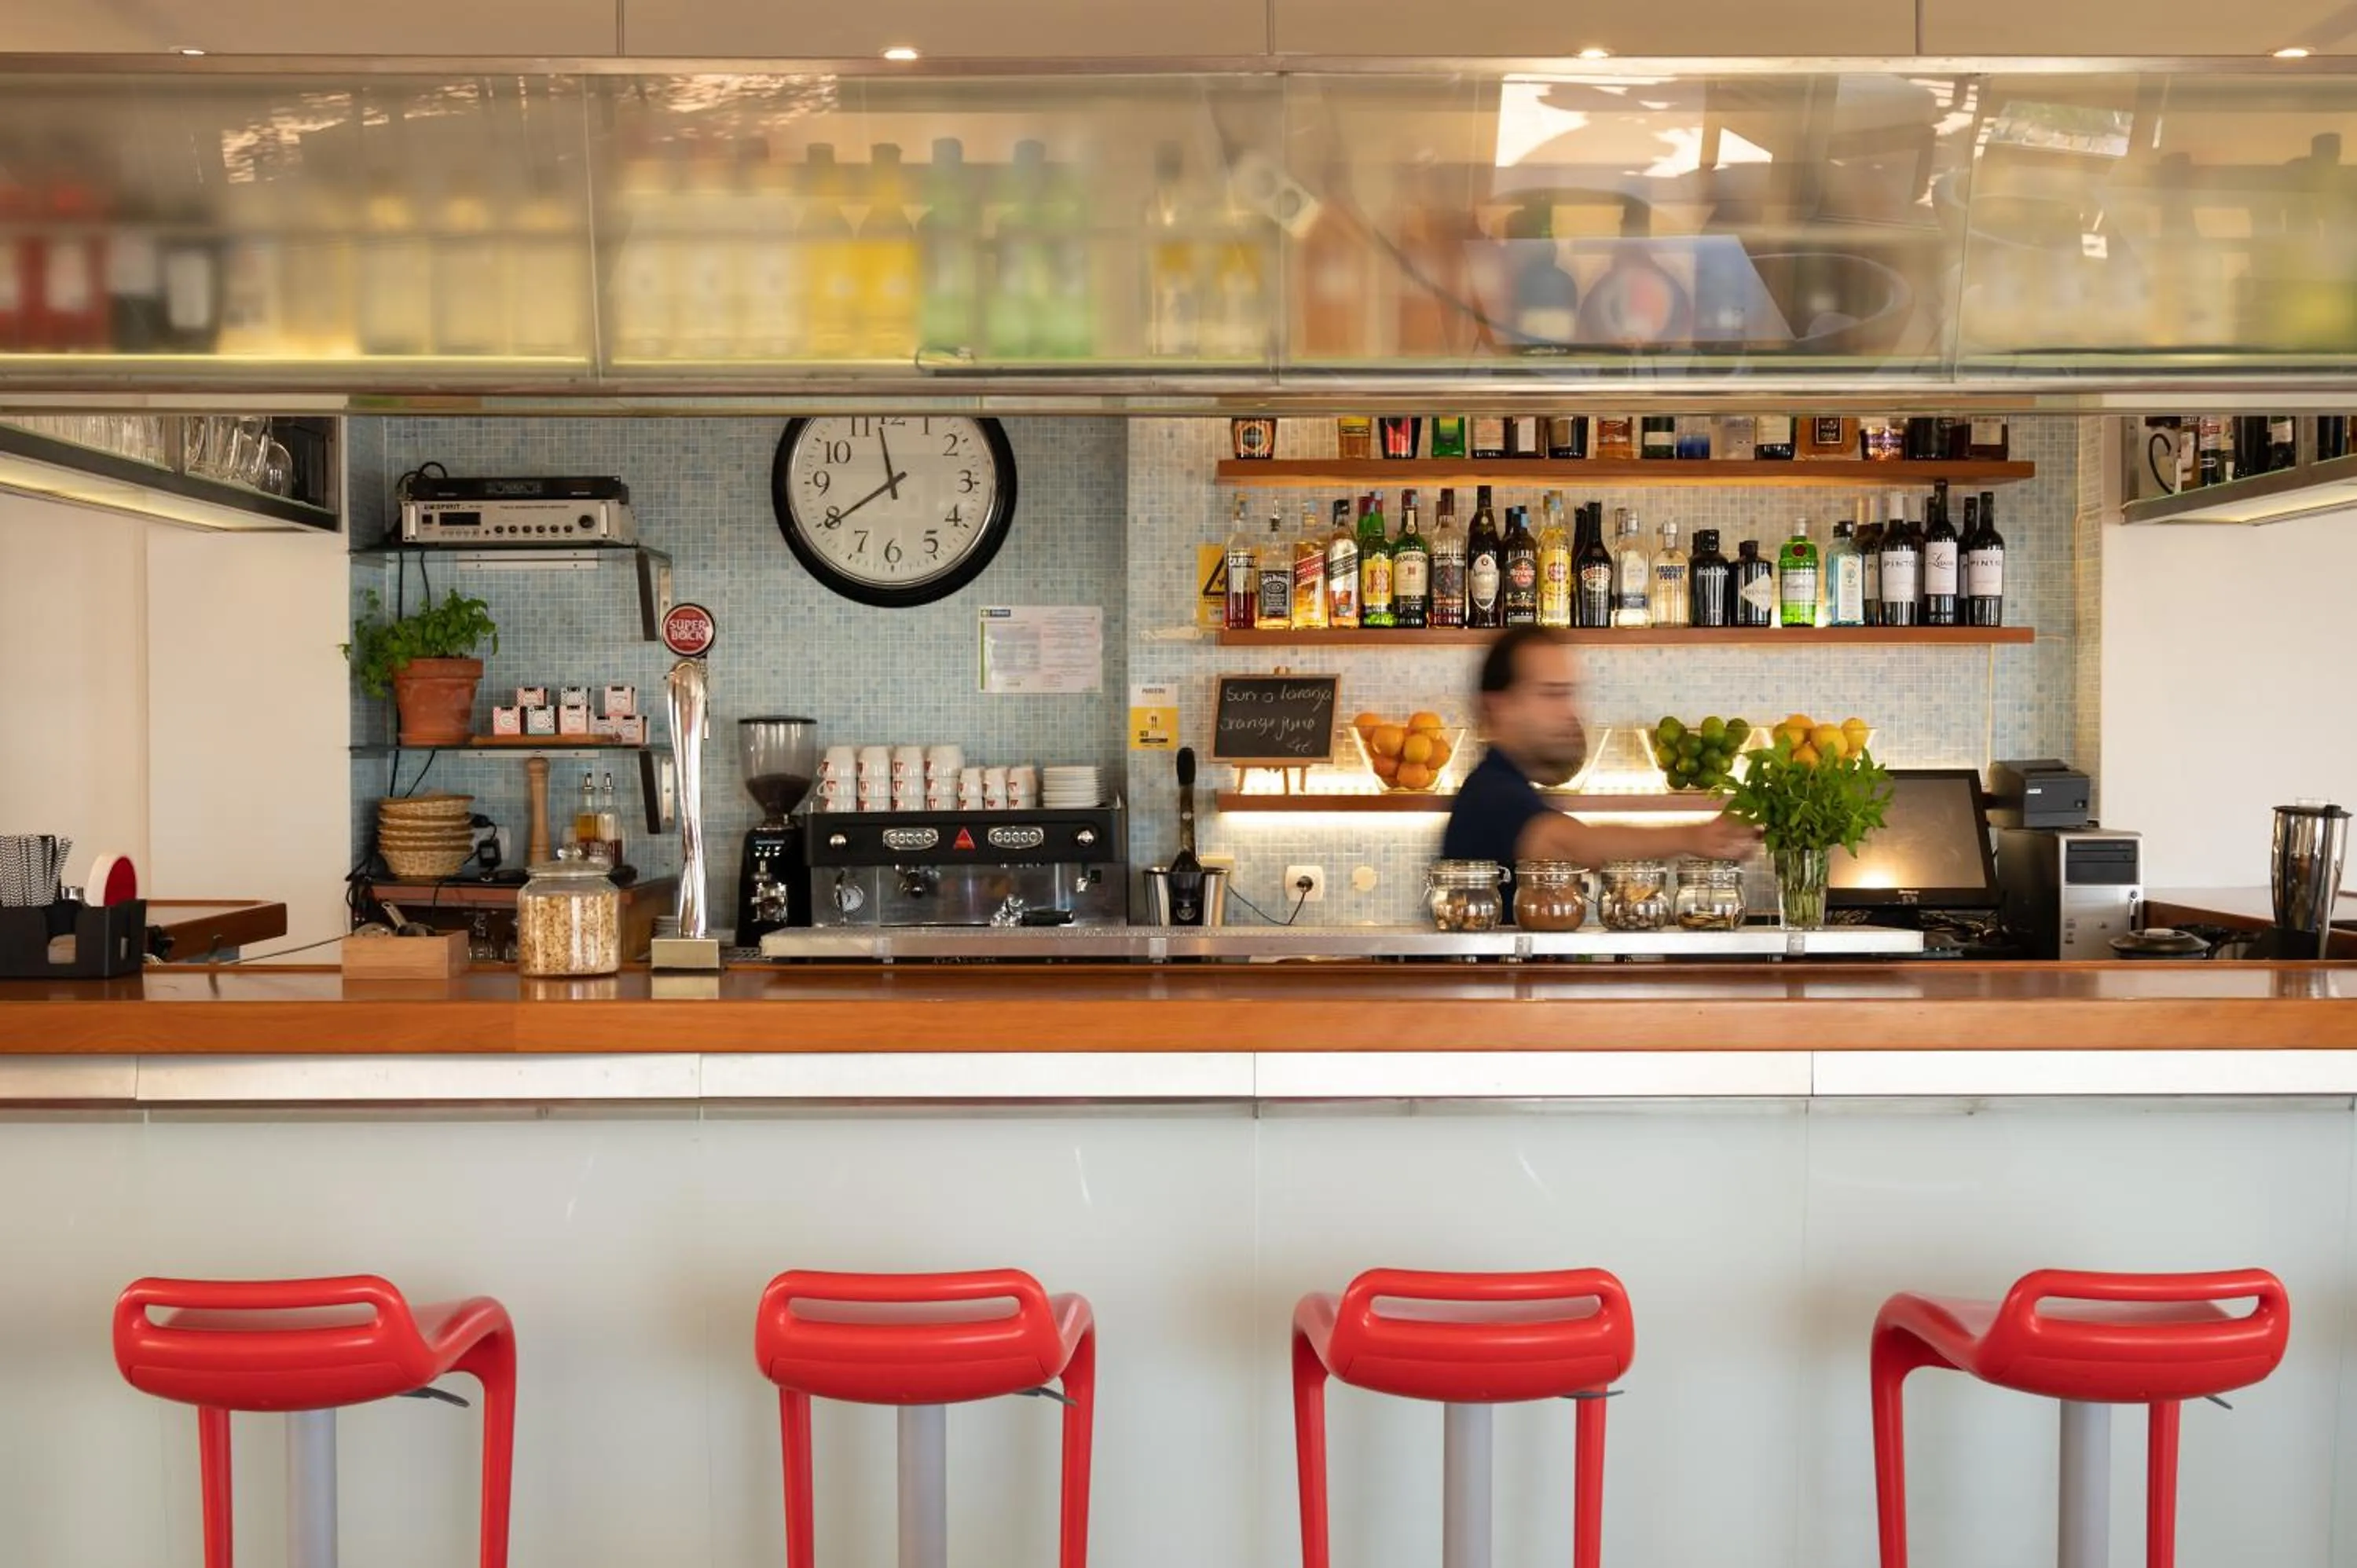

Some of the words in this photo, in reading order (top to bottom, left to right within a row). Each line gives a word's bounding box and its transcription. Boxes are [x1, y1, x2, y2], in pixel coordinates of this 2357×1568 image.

[850, 418, 871, 437] 11
[823, 441, 852, 464] 10
[942, 434, 959, 456] 2
[812, 471, 830, 497] 9
[957, 469, 973, 494] 3
[823, 505, 842, 530] 8
[944, 504, 962, 527] 4
[854, 529, 870, 554] 7
[883, 538, 903, 564] 6
[923, 529, 939, 555] 5
[669, 618, 708, 630] SUPER
[670, 628, 706, 641] BOCK
